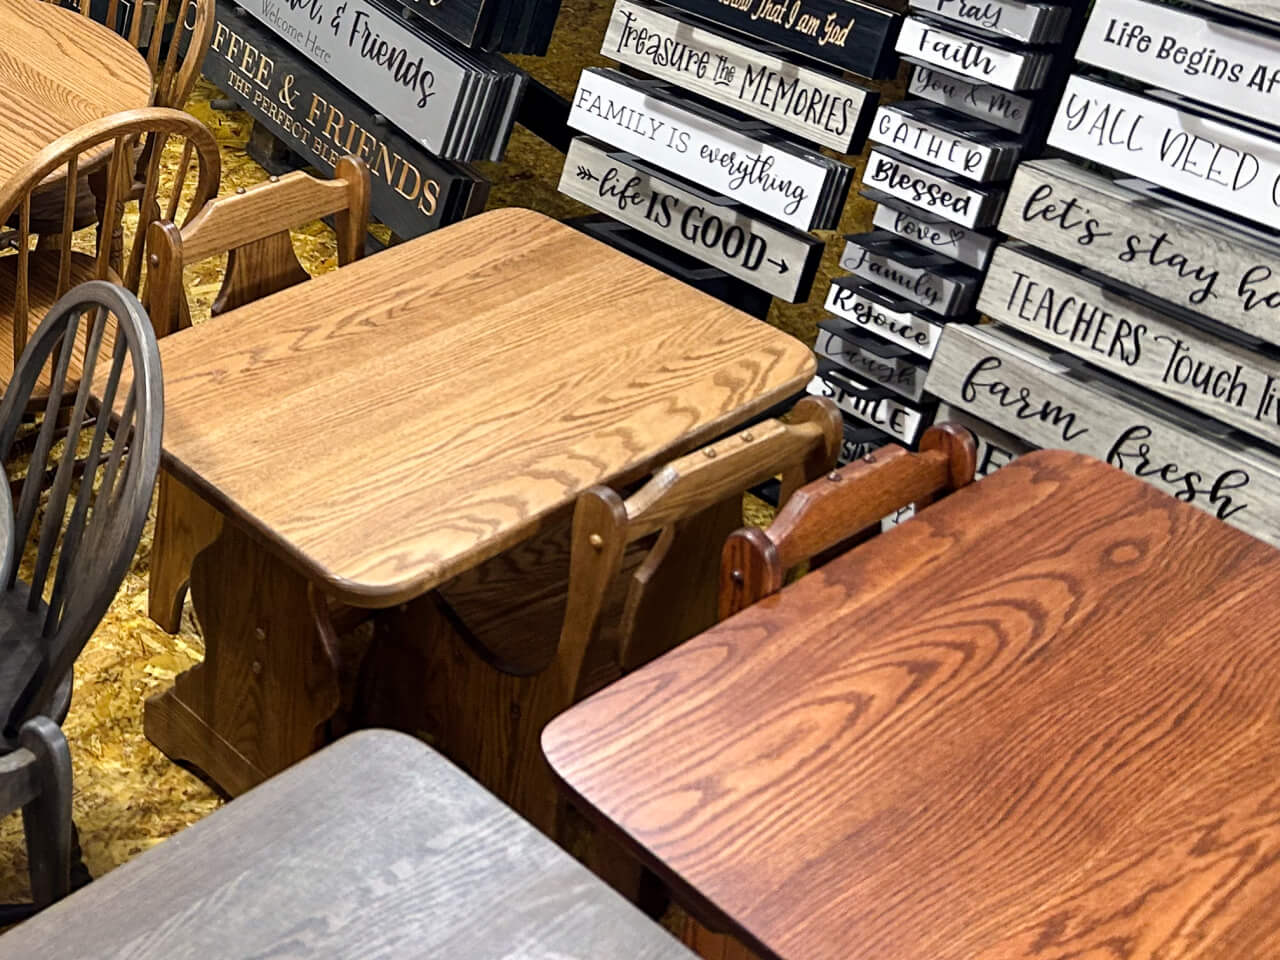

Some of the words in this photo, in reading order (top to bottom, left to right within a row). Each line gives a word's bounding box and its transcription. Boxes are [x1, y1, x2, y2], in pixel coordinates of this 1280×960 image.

[306, 35, 332, 64] Here
[331, 2, 346, 36] &
[349, 10, 435, 109] Friends
[616, 10, 710, 78] Treasure
[714, 54, 734, 83] The
[739, 65, 853, 135] MEMORIES
[919, 28, 996, 75] Faith
[1104, 19, 1151, 52] Life
[1156, 37, 1242, 82] Begins
[576, 88, 664, 140] FAMILY
[666, 127, 691, 154] IS
[700, 143, 809, 215] everything
[872, 159, 971, 216] Blessed
[879, 116, 983, 172] GATHER
[1066, 94, 1144, 152] Y'ALL
[1160, 127, 1259, 190] NEED
[599, 168, 644, 210] life
[646, 191, 678, 228] IS
[680, 205, 768, 272] GOOD
[833, 286, 928, 347] Rejoice
[1007, 272, 1148, 365] TEACHERS
[1156, 336, 1247, 406] Touch
[962, 357, 1089, 441] farm
[1106, 426, 1249, 519] fresh
